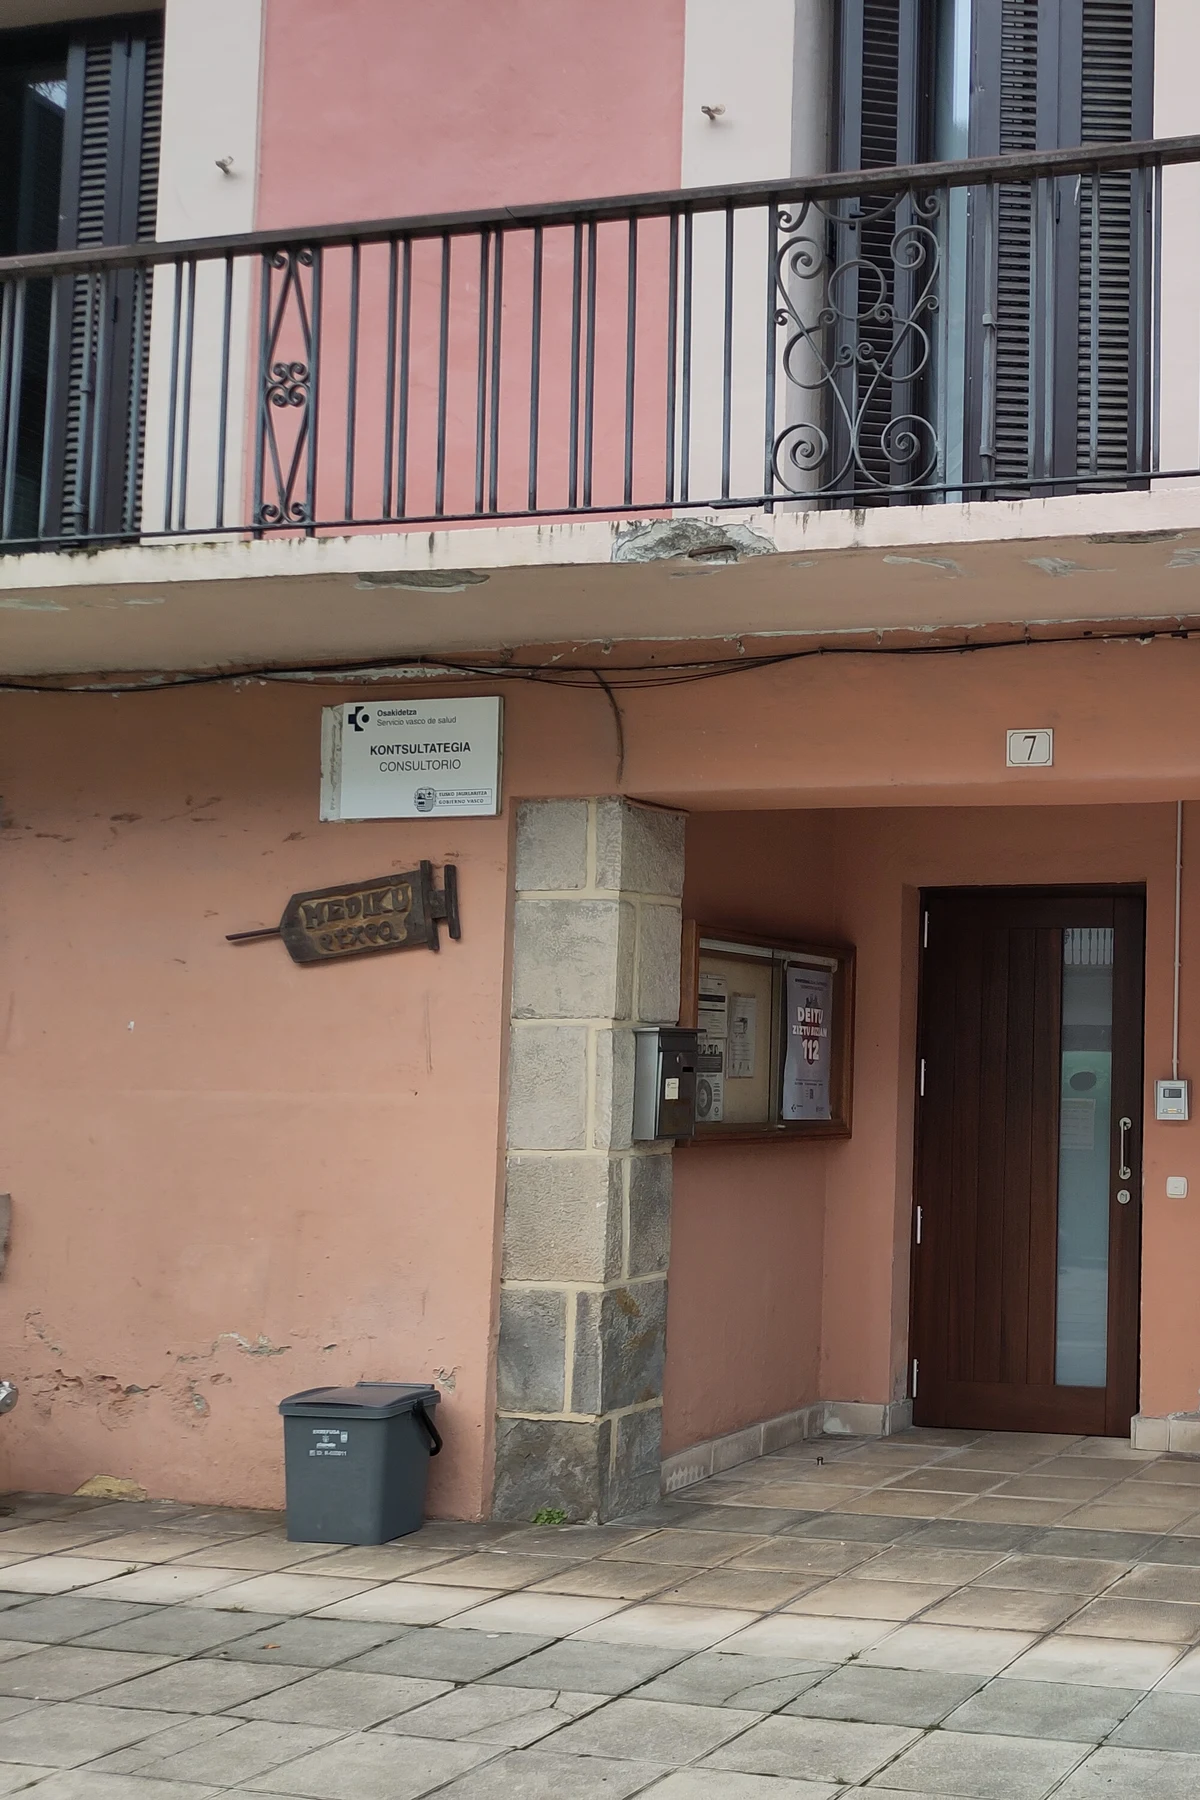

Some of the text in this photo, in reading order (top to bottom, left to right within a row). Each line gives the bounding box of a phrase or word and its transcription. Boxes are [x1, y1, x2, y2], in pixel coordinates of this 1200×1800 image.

[377, 708, 417, 717] Osakidetza
[377, 716, 457, 727] Servicio vasco de salud
[370, 741, 471, 756] KONTSULTATEGIA
[1023, 735, 1037, 761] 7
[379, 758, 461, 772] CONSULTORIO
[301, 886, 410, 930] MEDIKU
[797, 1006, 824, 1024] DEITU
[802, 1039, 820, 1060] 112
